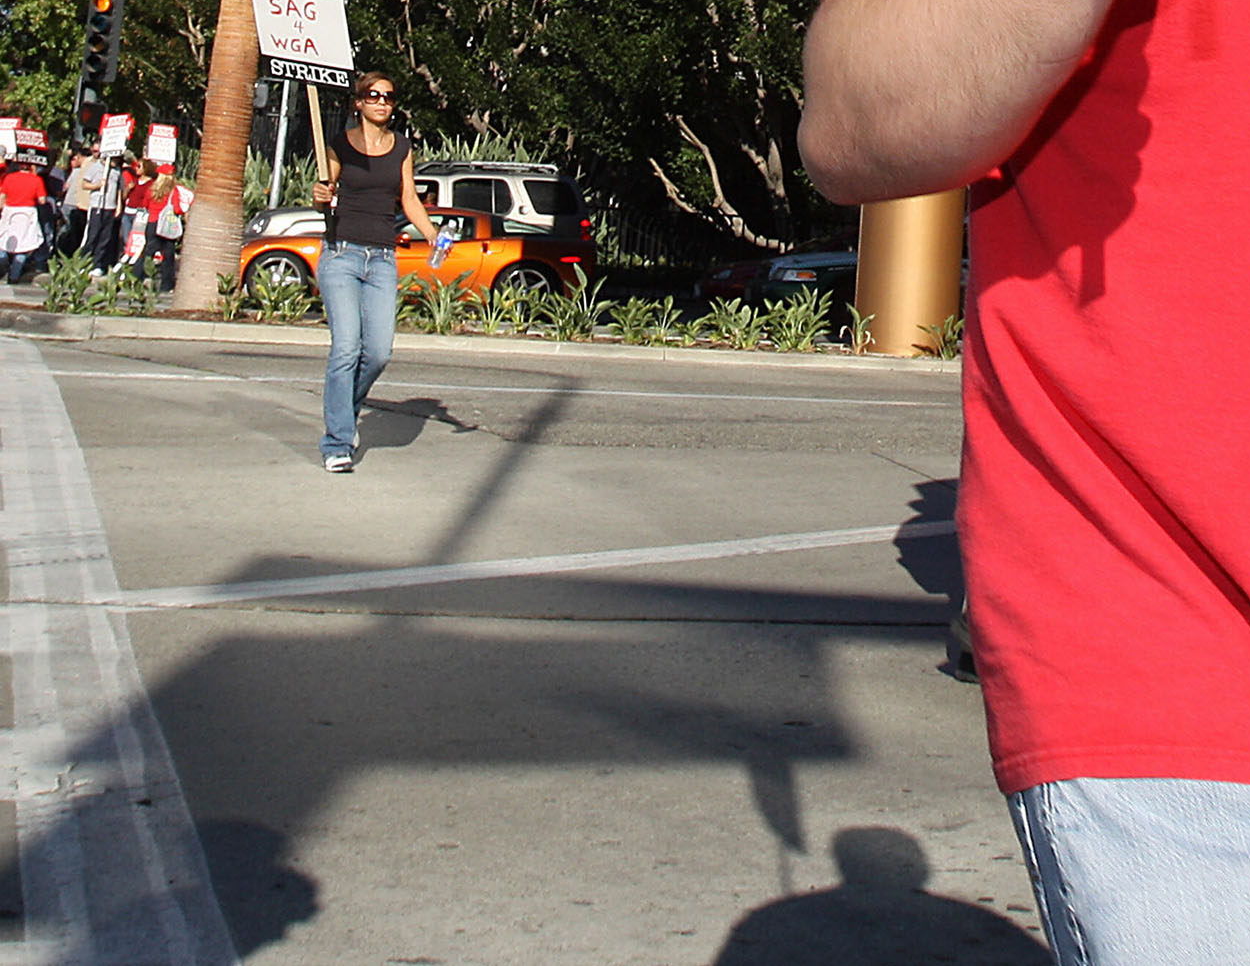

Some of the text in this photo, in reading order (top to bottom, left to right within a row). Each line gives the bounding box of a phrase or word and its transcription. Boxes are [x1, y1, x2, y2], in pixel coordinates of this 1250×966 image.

[294, 20, 305, 34] 4
[270, 33, 319, 56] WGA
[269, 58, 350, 88] STRIKE
